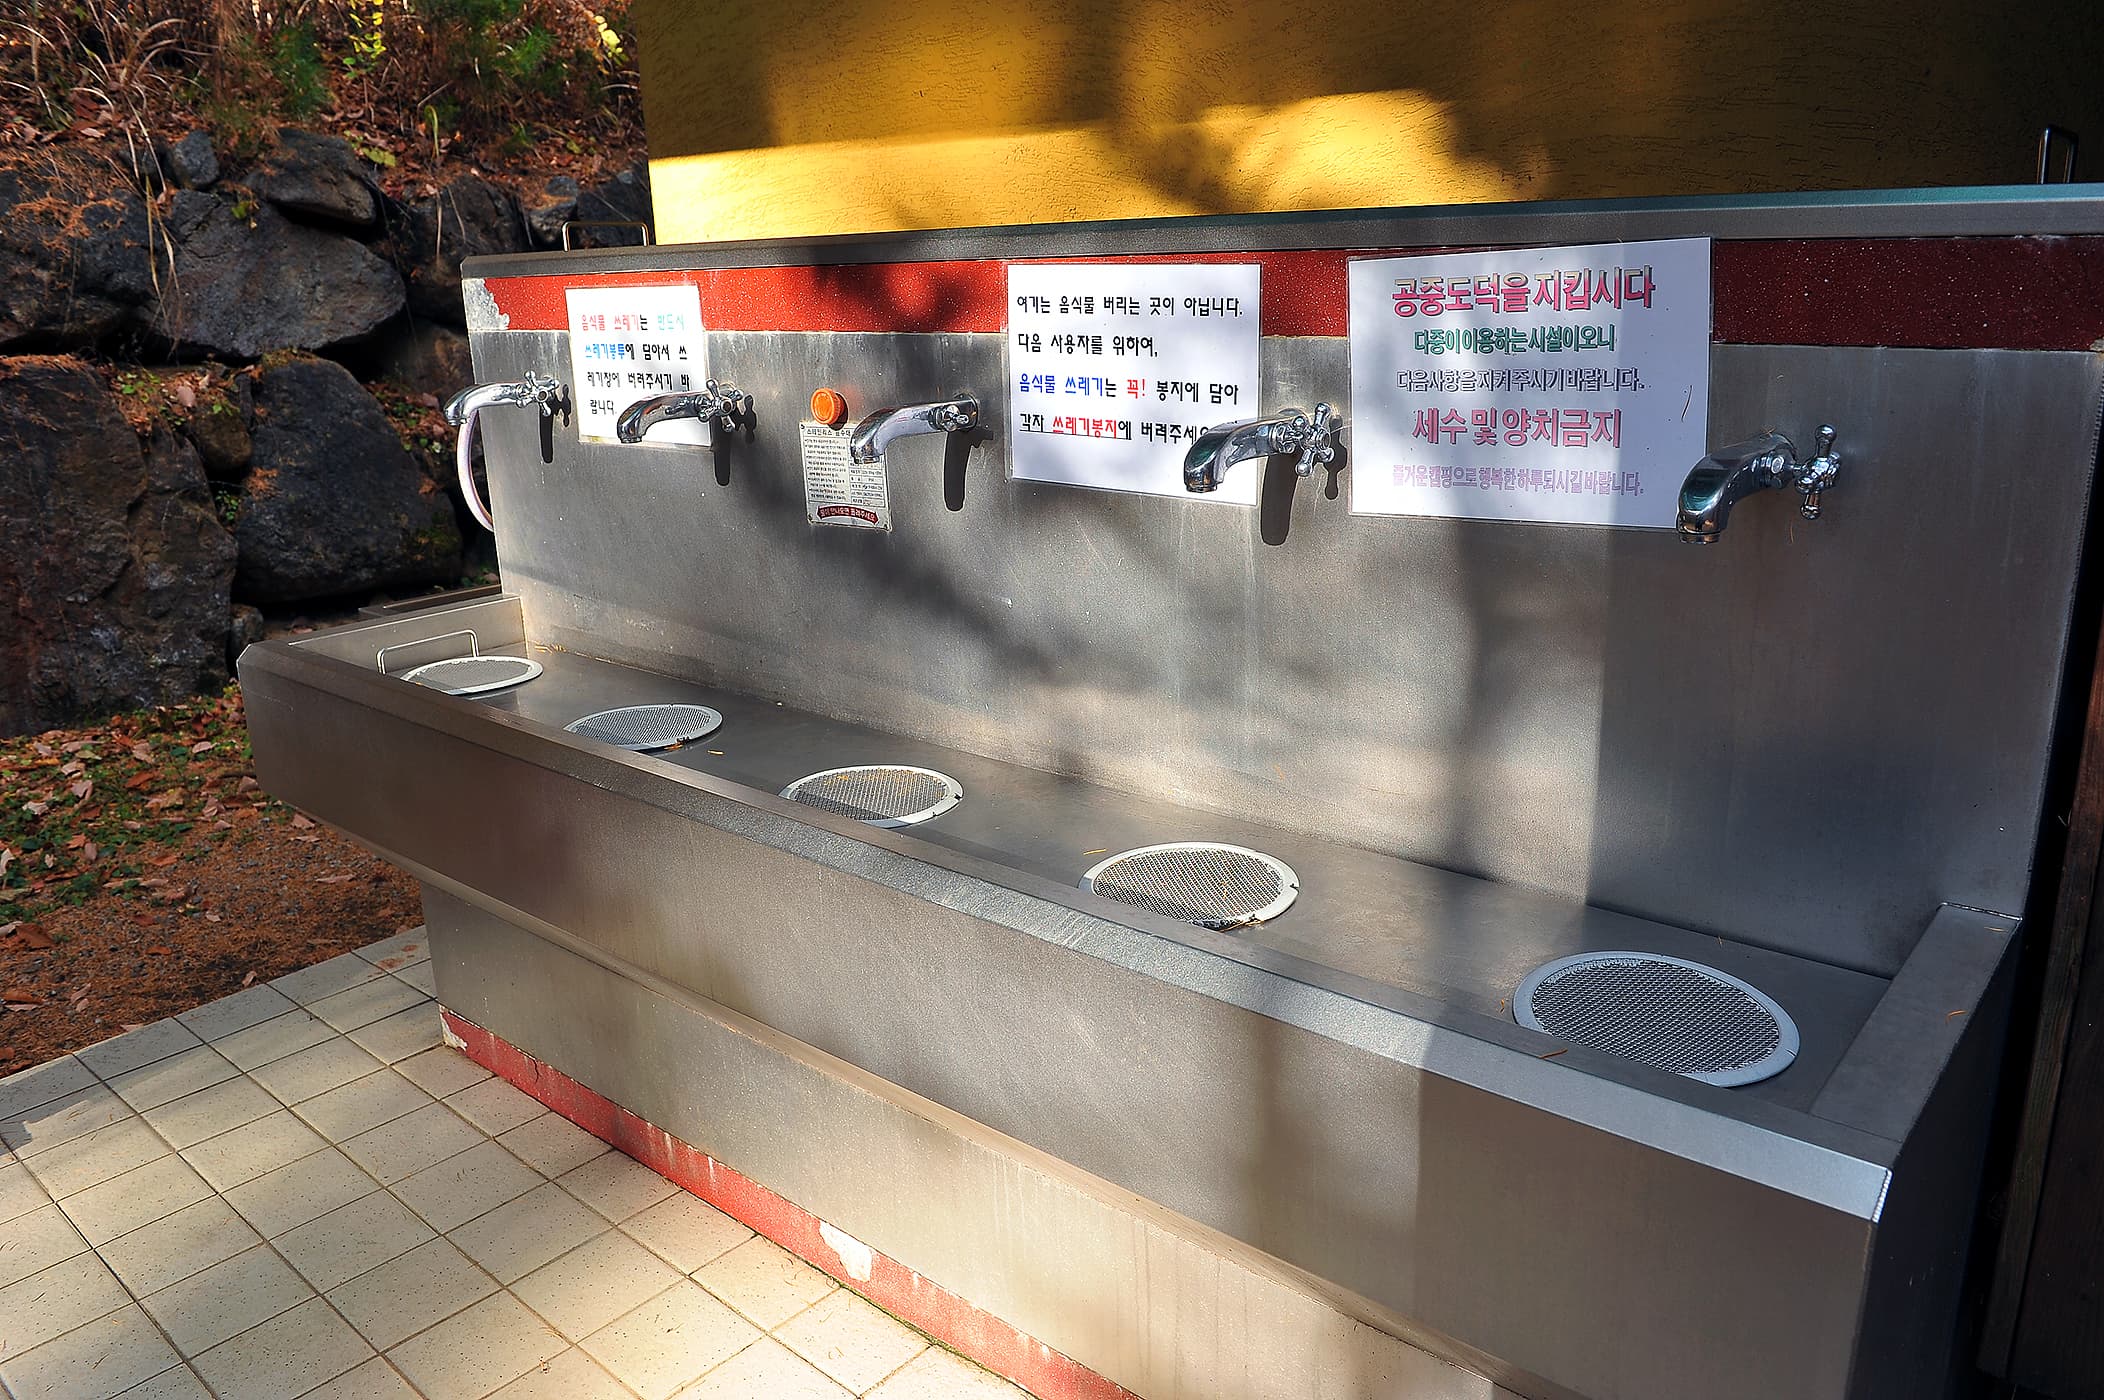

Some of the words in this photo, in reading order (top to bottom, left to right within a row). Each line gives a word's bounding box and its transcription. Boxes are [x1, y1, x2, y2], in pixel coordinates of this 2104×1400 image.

[1392, 273, 1531, 318] 공중도덕을
[1533, 264, 1656, 312] 지킵시다
[1017, 296, 1051, 314] 여기는
[1059, 296, 1095, 315] 음식물
[1103, 296, 1140, 316] 버리는
[1149, 296, 1175, 316] 곳이
[1184, 296, 1243, 318] 아닙니다.
[582, 314, 606, 331] 음식물
[614, 314, 648, 331] 쓰레기는
[585, 344, 635, 360] 쓰레기봉투에
[642, 344, 670, 361] 담아서
[678, 346, 688, 360] 쓰
[1018, 334, 1042, 353] 다음
[1051, 334, 1103, 355] 사용자를
[1112, 336, 1158, 358] 위하여,
[628, 372, 673, 390] 버려주시기
[1019, 374, 1056, 394] 음식물
[1064, 376, 1117, 398] 쓰레기는
[1126, 378, 1146, 399] 꼭!
[1156, 380, 1199, 403] 봉지에
[1209, 383, 1239, 405] 담아
[1478, 368, 1564, 392] 지켜주시기
[1567, 368, 1645, 392] 바랍니다.
[1020, 413, 1044, 432] 각자
[1052, 416, 1132, 440] 쓰레기봉지에
[1141, 422, 1209, 445] 버려주세
[1412, 408, 1468, 445] 세수
[1471, 408, 1498, 446] 및
[1502, 408, 1622, 448] 양치금지
